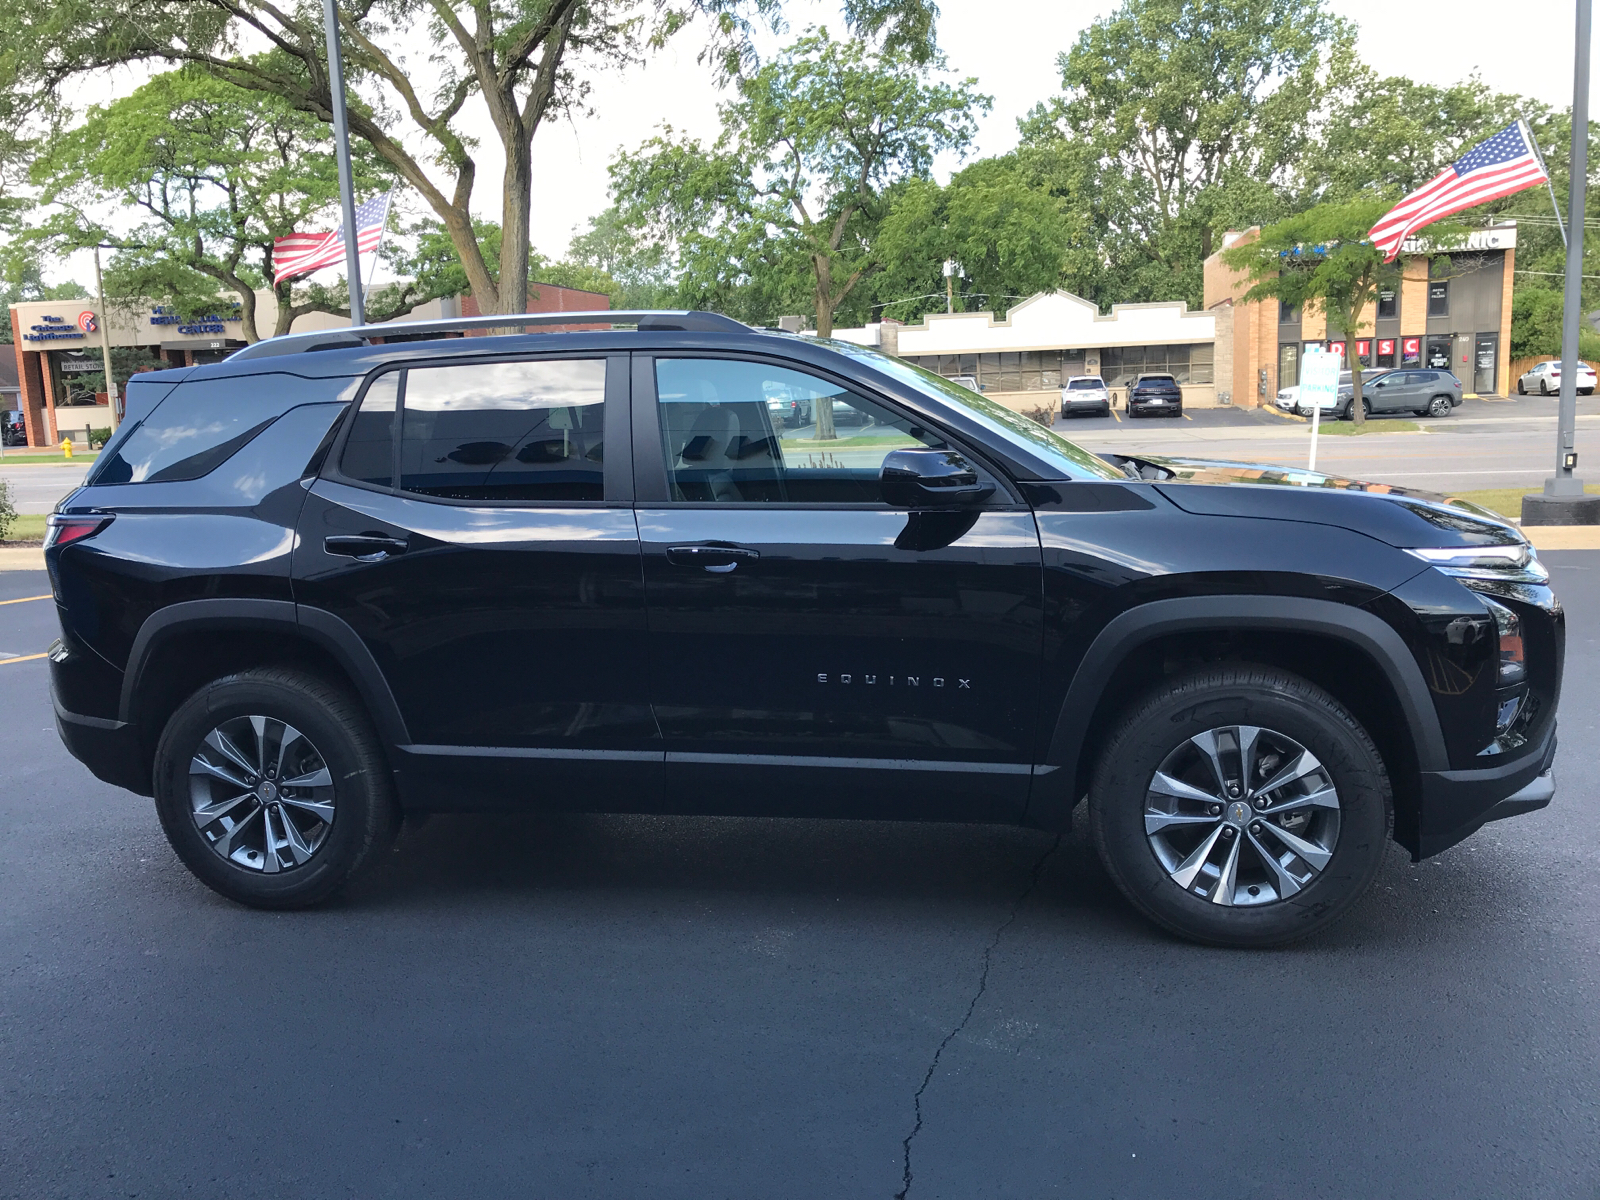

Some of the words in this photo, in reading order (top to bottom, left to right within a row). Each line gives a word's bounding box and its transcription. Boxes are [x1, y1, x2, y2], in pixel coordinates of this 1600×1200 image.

[31, 324, 74, 332] Chicago
[178, 324, 224, 334] CENTER
[23, 333, 84, 342] Lighthouse
[1305, 367, 1336, 376] VISITOR
[1302, 384, 1335, 393] PARKING
[817, 673, 970, 689] EQUINOX
